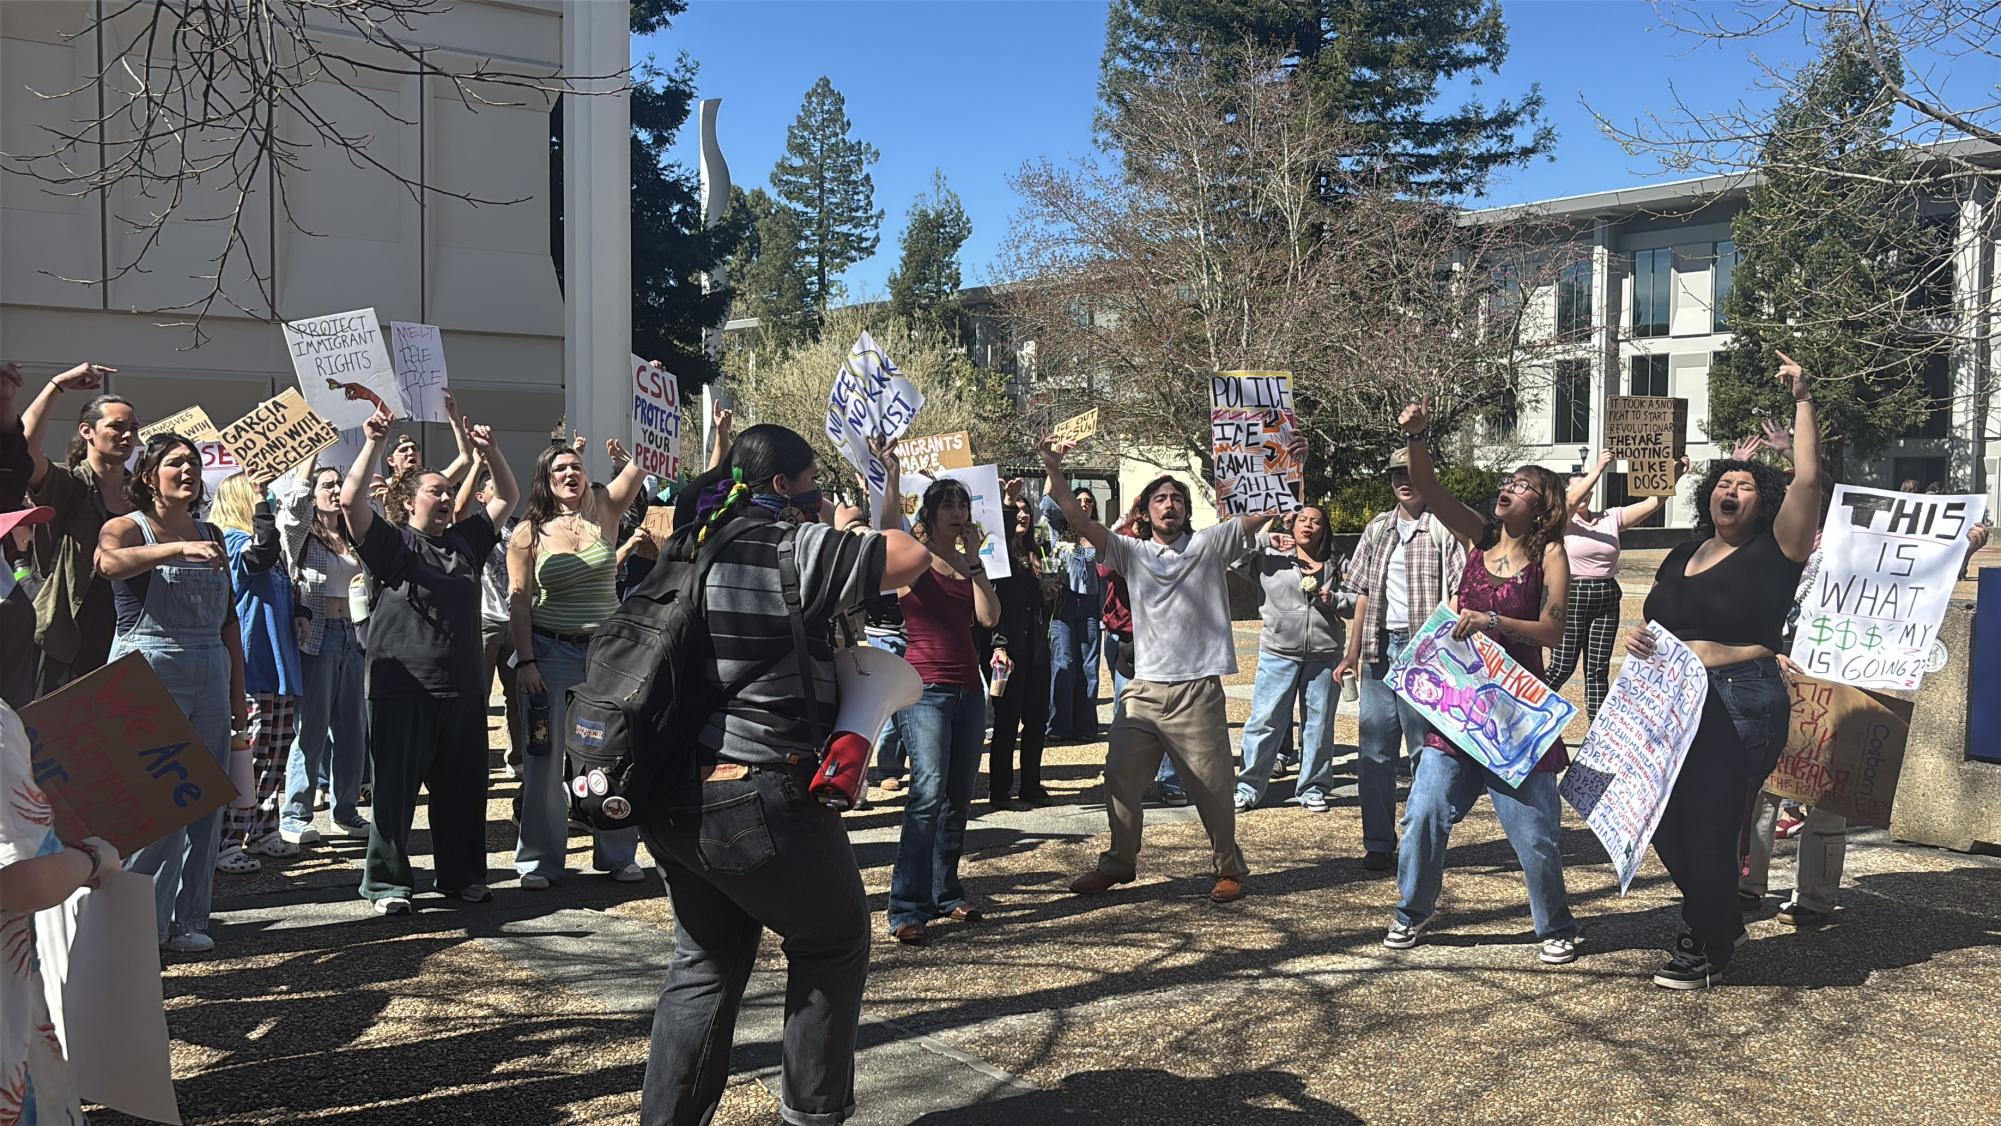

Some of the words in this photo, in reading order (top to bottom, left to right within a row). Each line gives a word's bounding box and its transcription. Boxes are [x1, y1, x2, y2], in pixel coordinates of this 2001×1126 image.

[297, 315, 366, 338] PROTECT
[396, 326, 437, 341] MELT
[293, 330, 376, 357] IMMIGRANT
[314, 350, 372, 376] RIGHTS
[636, 365, 678, 413] CSU,
[832, 370, 856, 415] ICE
[848, 398, 867, 435] NO
[864, 356, 898, 403] KKK
[1212, 376, 1288, 409] POLICE
[634, 395, 680, 438] PROTECT
[1609, 410, 1629, 421] FIGHT
[1632, 410, 1641, 420] TO
[1644, 411, 1667, 421] START
[1611, 399, 1620, 409] IT
[1623, 399, 1647, 409] TOOK
[1648, 400, 1654, 409] A
[141, 411, 194, 438] SEAWOLVES
[184, 420, 212, 438] WITH
[221, 399, 289, 444] GARCIA
[828, 405, 843, 441] NO
[1076, 410, 1097, 425] OUT
[234, 438, 258, 461] DO
[254, 412, 288, 442] YOU
[246, 437, 288, 471] STAND
[282, 410, 321, 442] WITH
[641, 427, 670, 453] YOUR
[1213, 422, 1261, 448] ICE
[1608, 435, 1637, 446] THEY
[1638, 433, 1663, 446] ARE
[635, 442, 679, 482] PEOPLE
[899, 452, 940, 473] MAKE
[1609, 446, 1671, 459] SHOOTING
[868, 459, 886, 491] NO
[1217, 454, 1264, 479] SAME
[1631, 461, 1667, 473] LIKE
[1234, 473, 1287, 495] SHIT
[1634, 474, 1674, 490] DOGS.
[1841, 491, 1967, 540] THIS
[1876, 542, 1918, 576] IS
[1820, 571, 1925, 619] WHAT
[1899, 623, 1933, 648] MY
[1808, 649, 1831, 674] IS
[98, 668, 161, 744] We
[138, 741, 202, 808] Are
